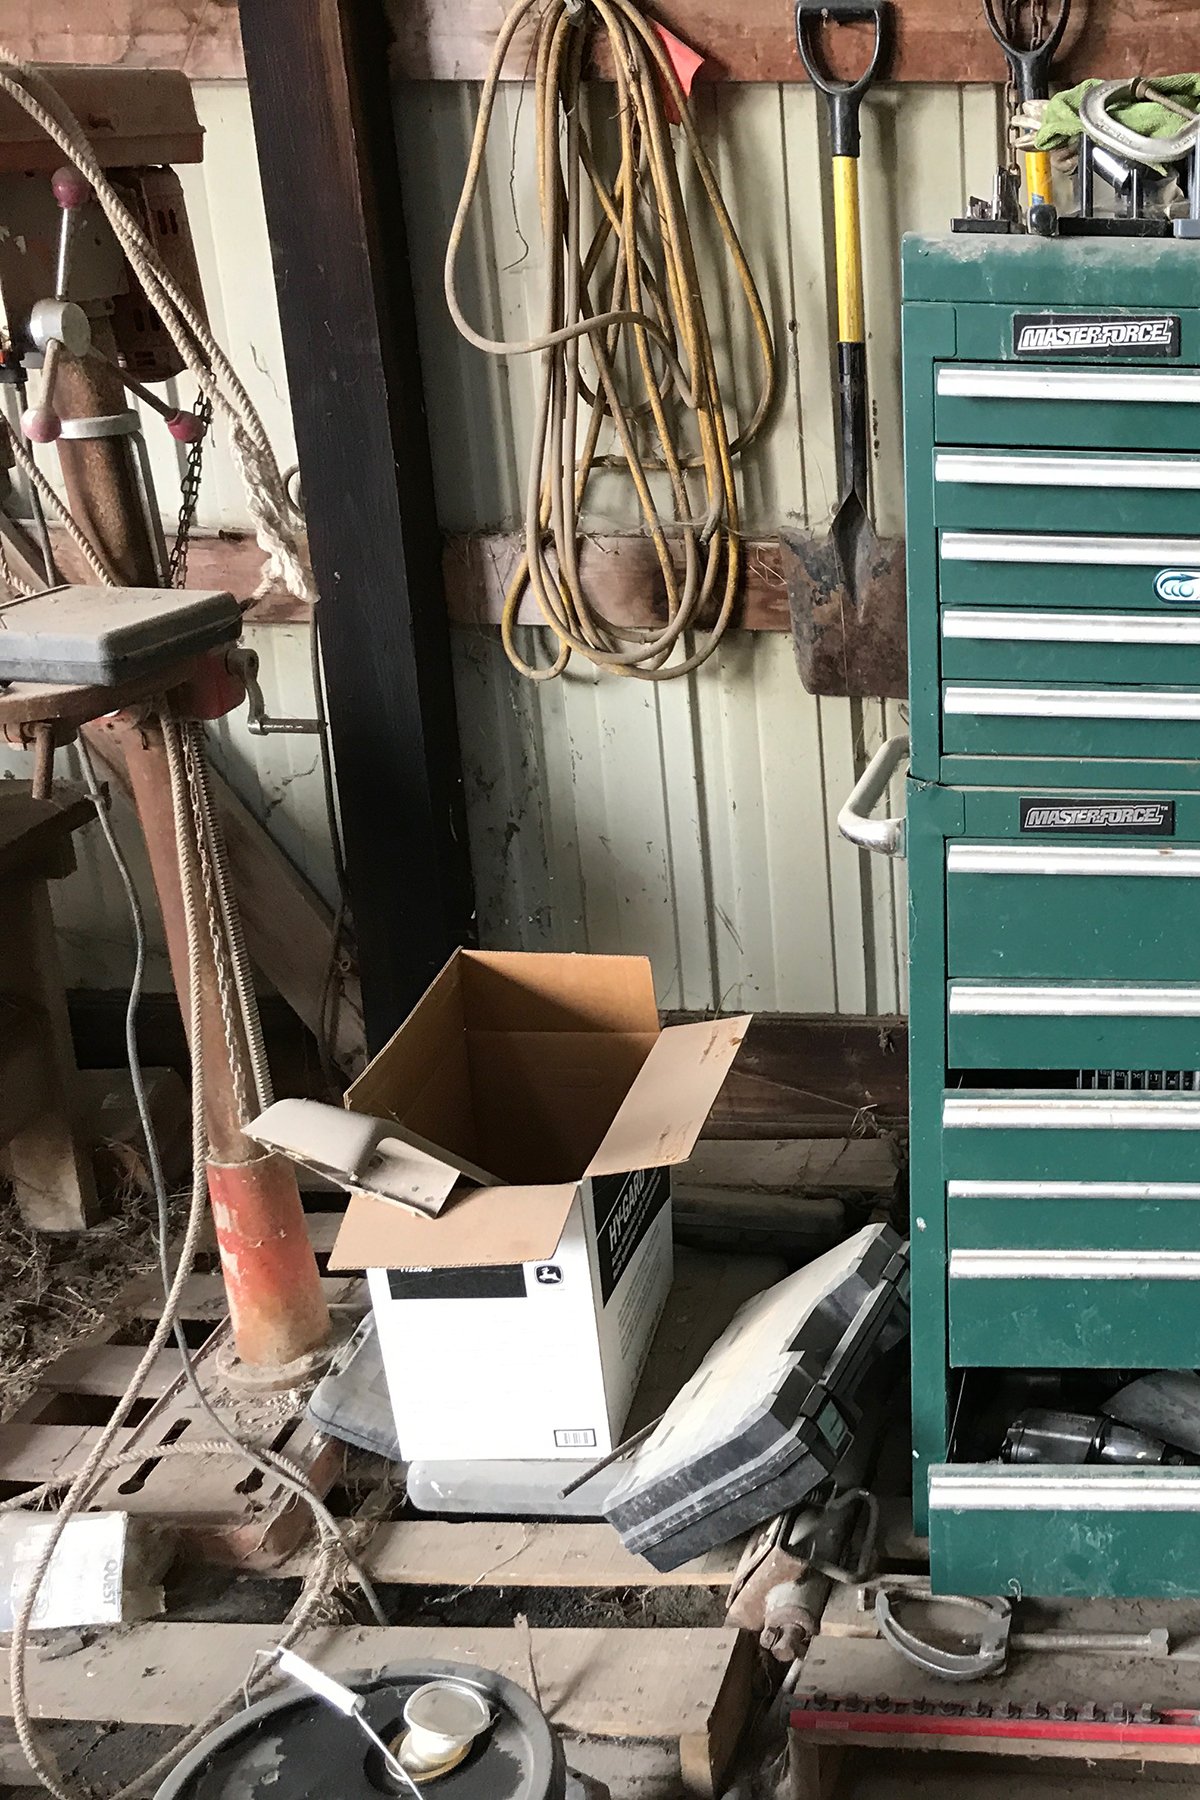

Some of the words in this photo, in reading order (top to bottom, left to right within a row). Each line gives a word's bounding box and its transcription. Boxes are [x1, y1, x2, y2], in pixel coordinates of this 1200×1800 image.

[1020, 322, 1170, 349] MASTERFORCE
[1027, 807, 1161, 826] MASTERFORCE
[103, 1559, 118, 1606] QUEST
